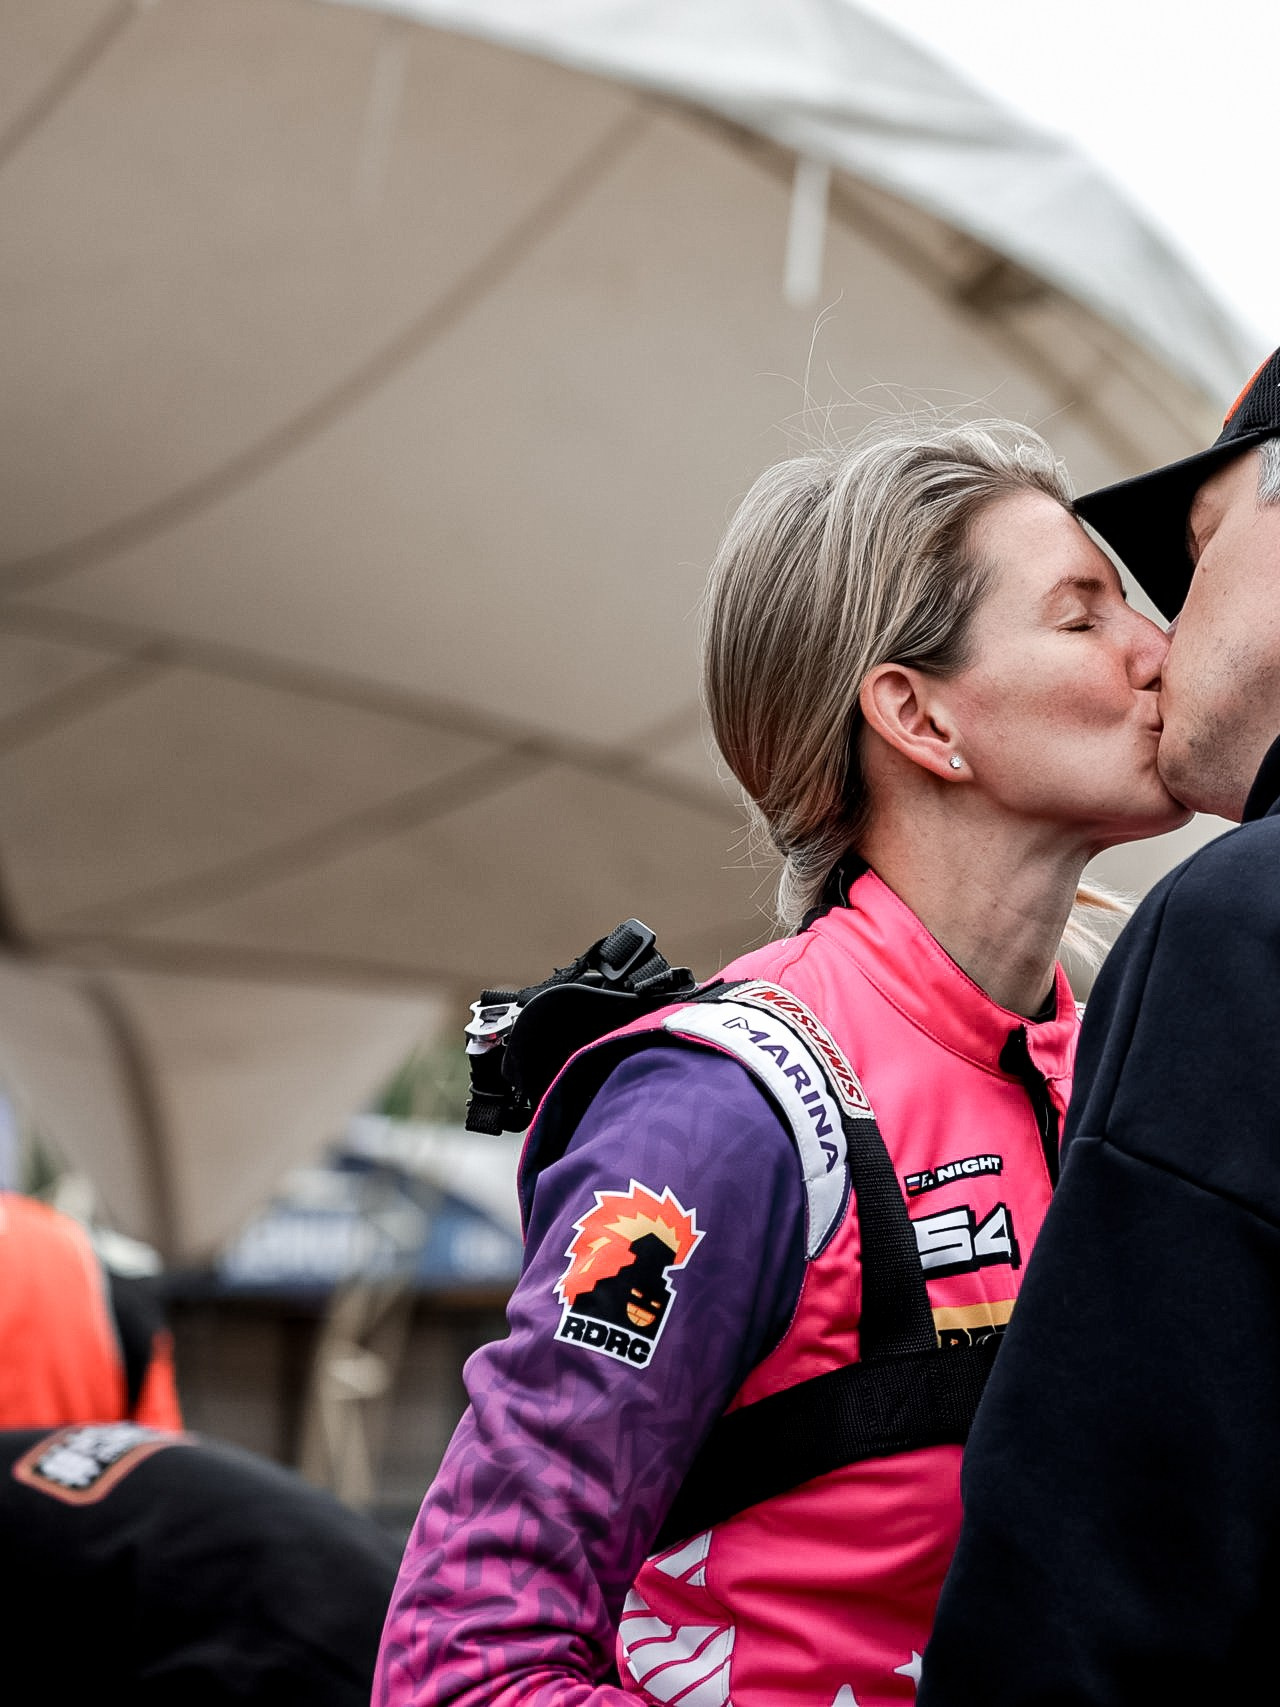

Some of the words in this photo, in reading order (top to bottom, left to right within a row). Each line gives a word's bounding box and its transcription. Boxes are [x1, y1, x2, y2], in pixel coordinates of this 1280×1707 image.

[751, 990, 863, 1102] SIMPSON
[722, 1017, 839, 1173] MARINA
[937, 1156, 1000, 1183] NIGHT
[912, 1206, 1013, 1270] 54
